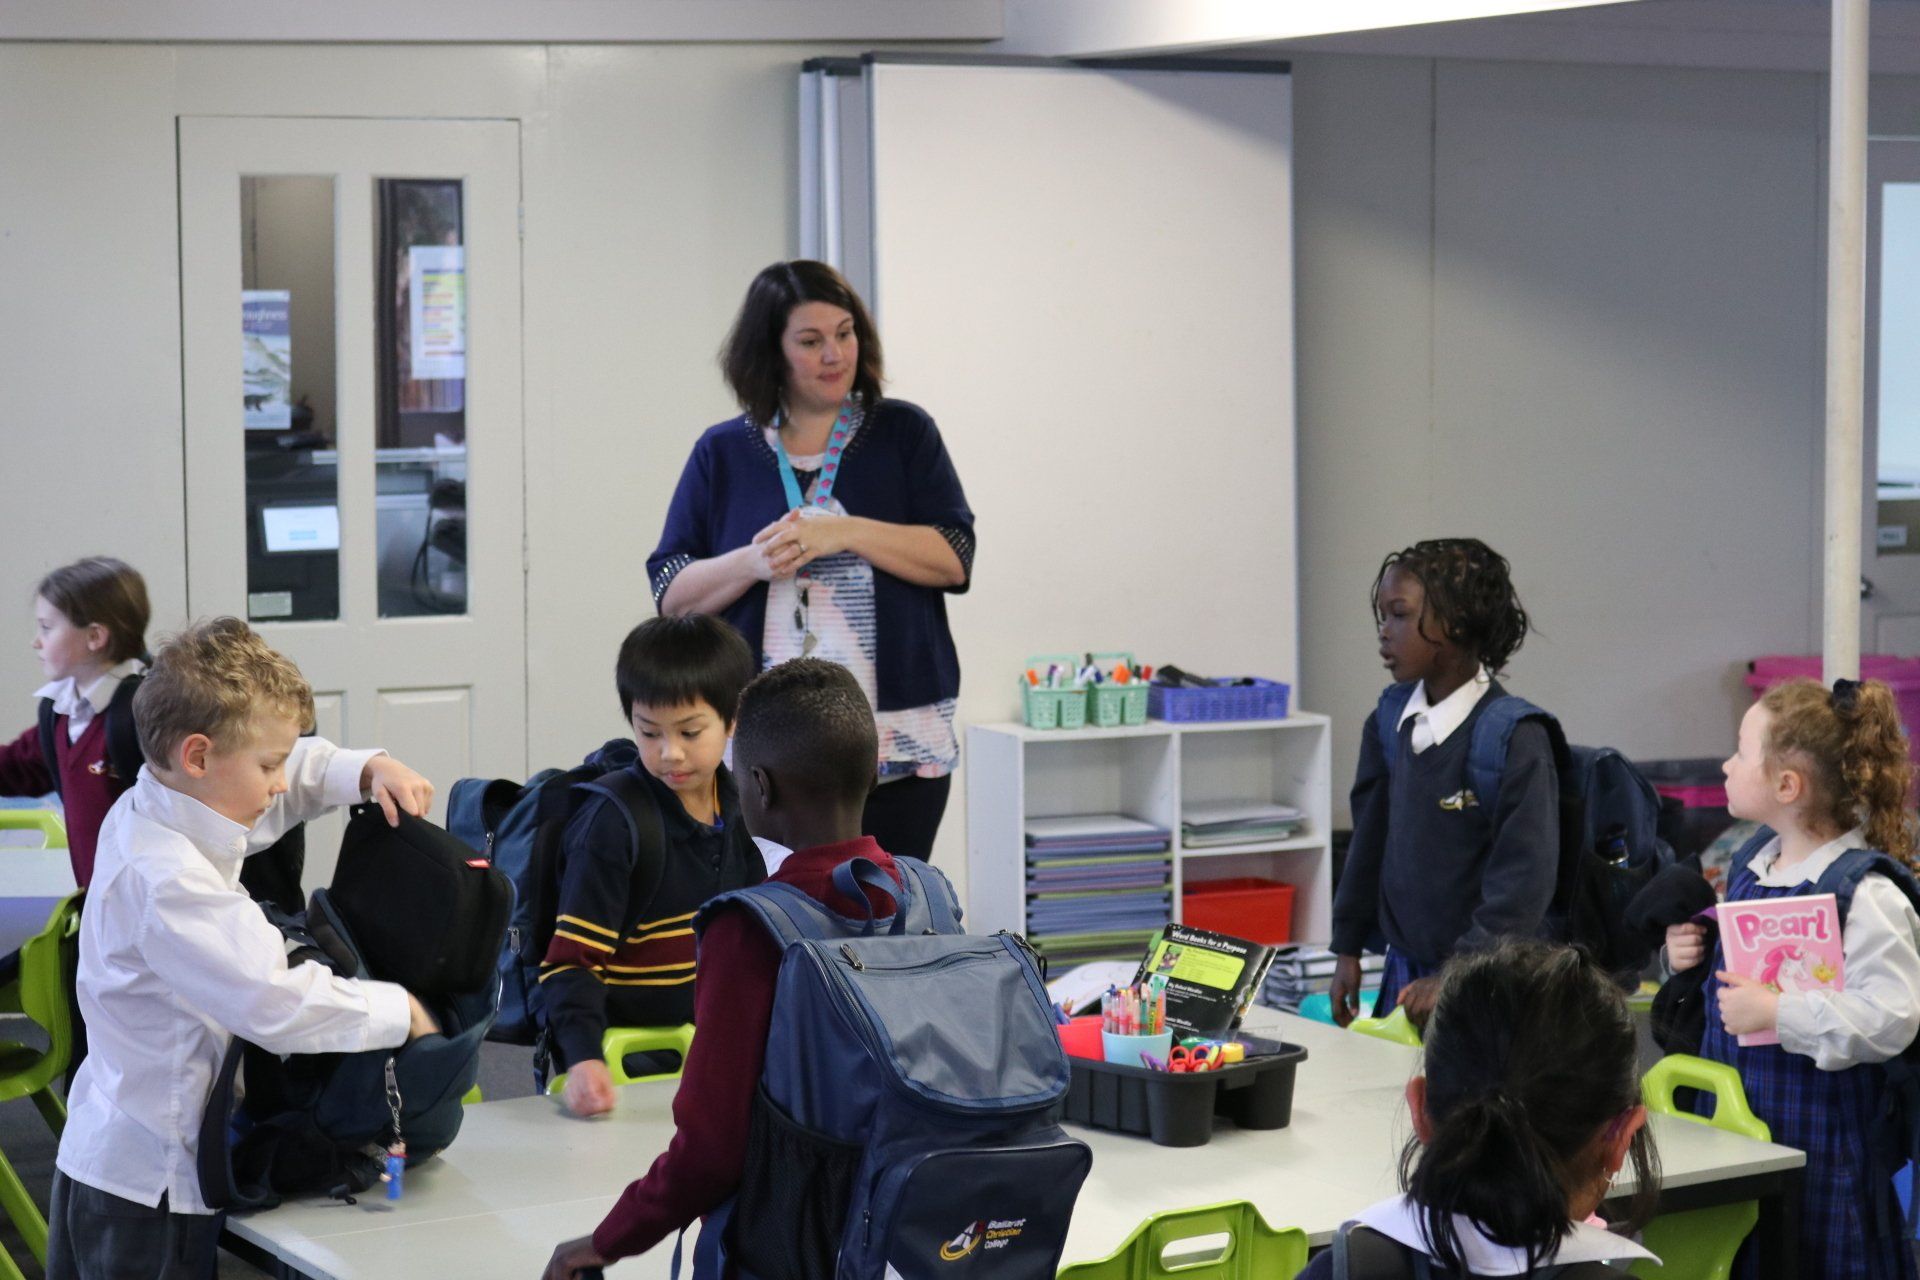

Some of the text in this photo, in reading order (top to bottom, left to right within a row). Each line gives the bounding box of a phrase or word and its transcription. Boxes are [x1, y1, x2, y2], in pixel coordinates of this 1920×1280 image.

[1735, 907, 1830, 950] Pearl
[1172, 930, 1189, 940] Word
[1208, 937, 1217, 946] for
[1222, 941, 1247, 953] Purpose
[984, 1239, 1009, 1249] College
